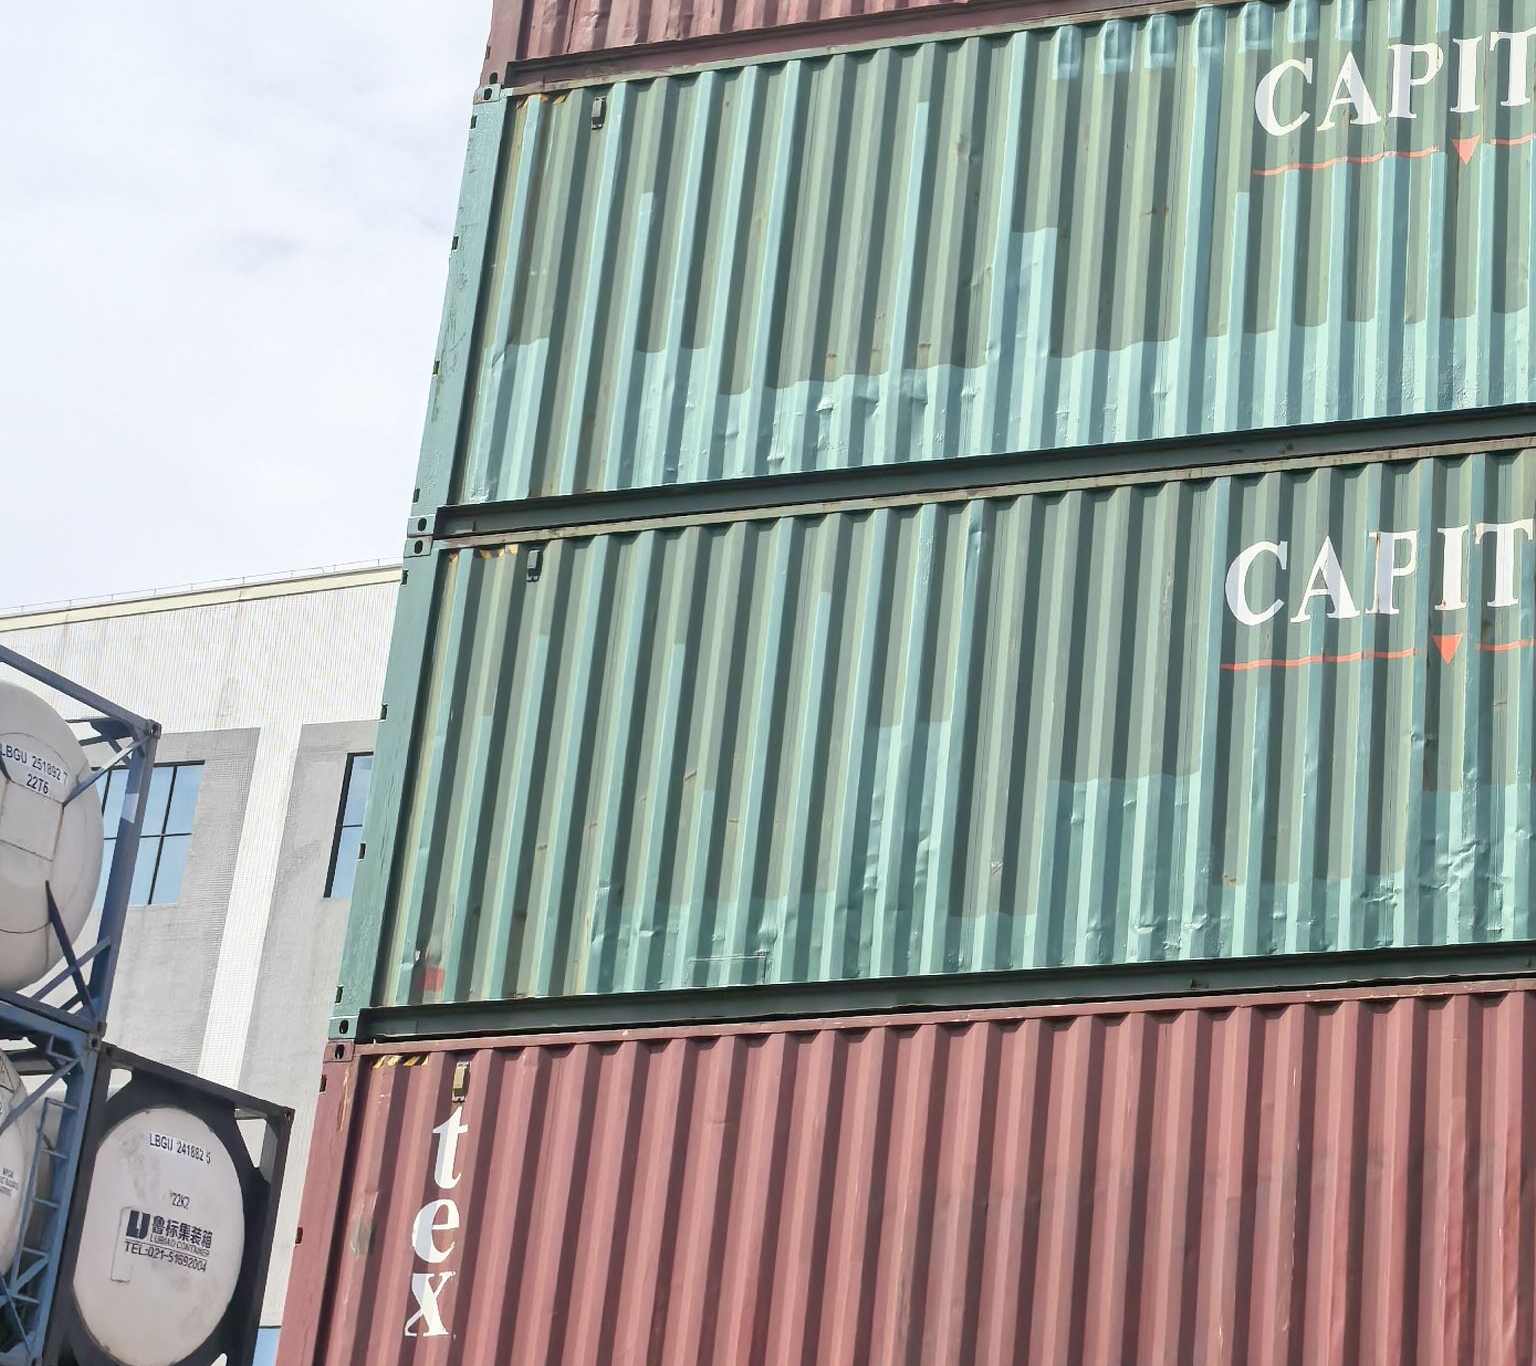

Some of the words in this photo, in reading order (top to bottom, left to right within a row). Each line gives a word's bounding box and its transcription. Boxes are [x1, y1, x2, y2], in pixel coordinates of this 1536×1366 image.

[26, 772, 50, 795] 22T6
[148, 1133, 174, 1152] LBGU
[405, 1105, 469, 1337] tex
